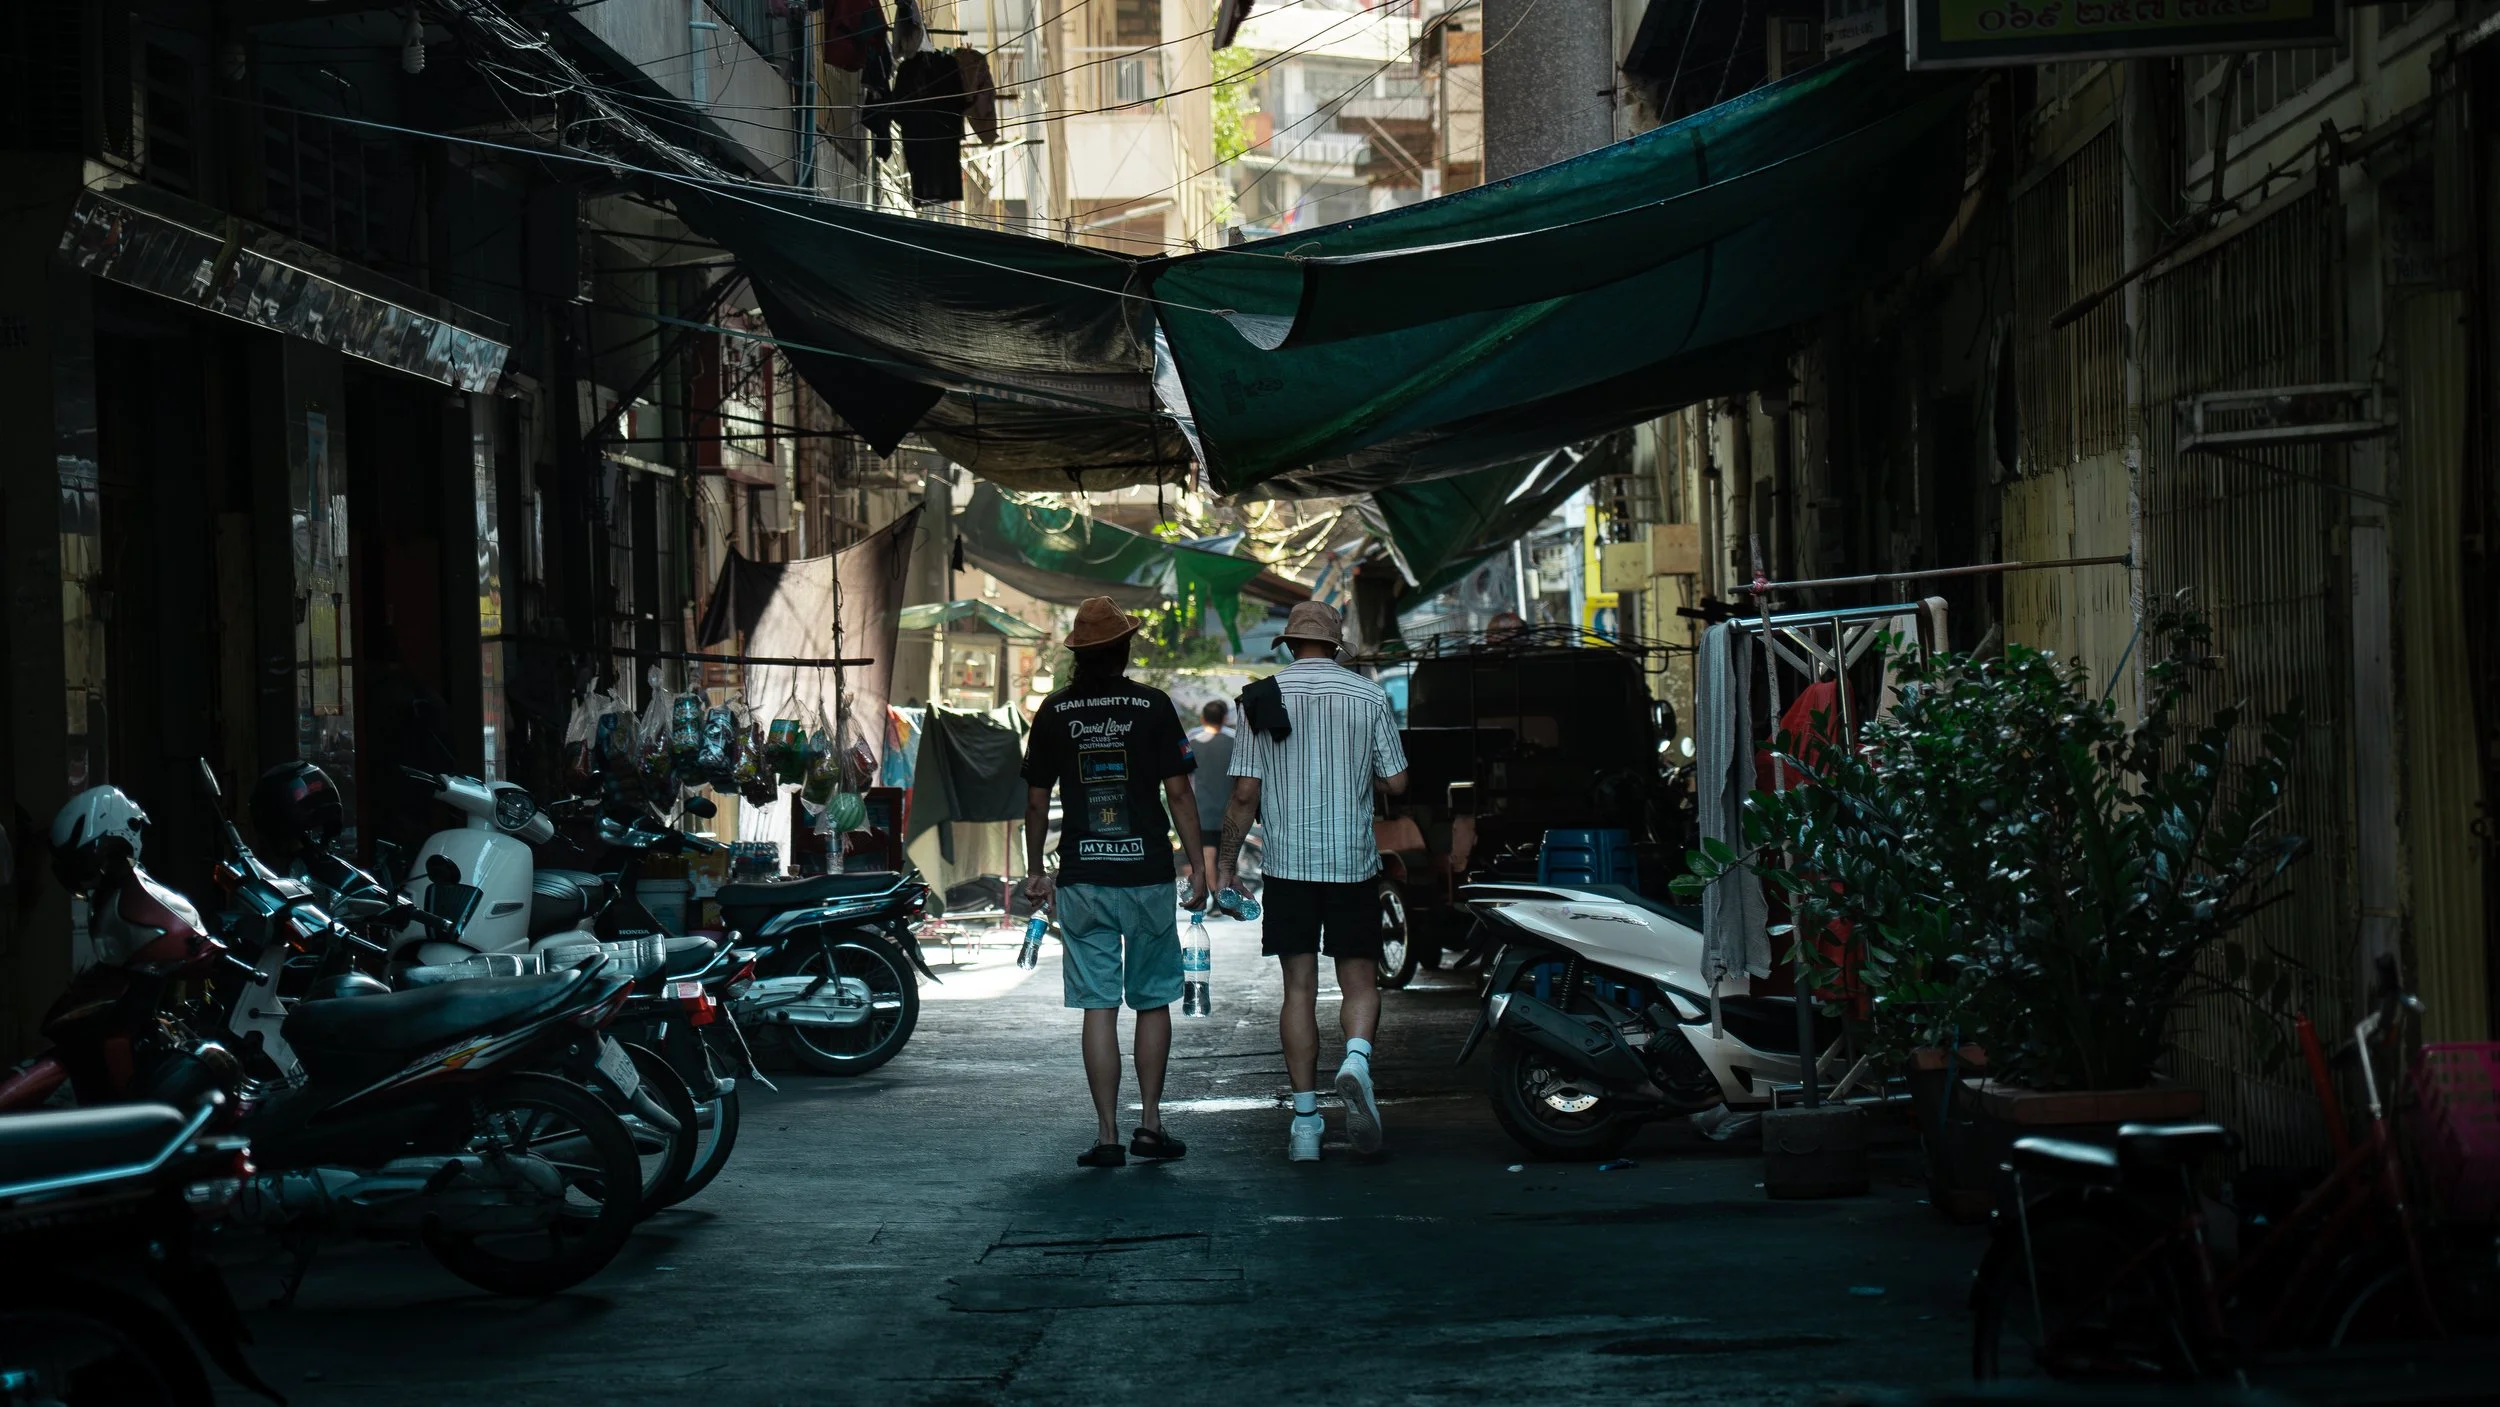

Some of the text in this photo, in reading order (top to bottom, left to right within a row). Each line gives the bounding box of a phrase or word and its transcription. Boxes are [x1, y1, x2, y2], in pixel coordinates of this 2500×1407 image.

[1054, 696, 1151, 713] TEAM MIGHTY MO
[1068, 717, 1133, 739] David Lloyd
[1078, 741, 1125, 750] SOUTHAMPTON
[1083, 842, 1140, 853] MYRIAD
